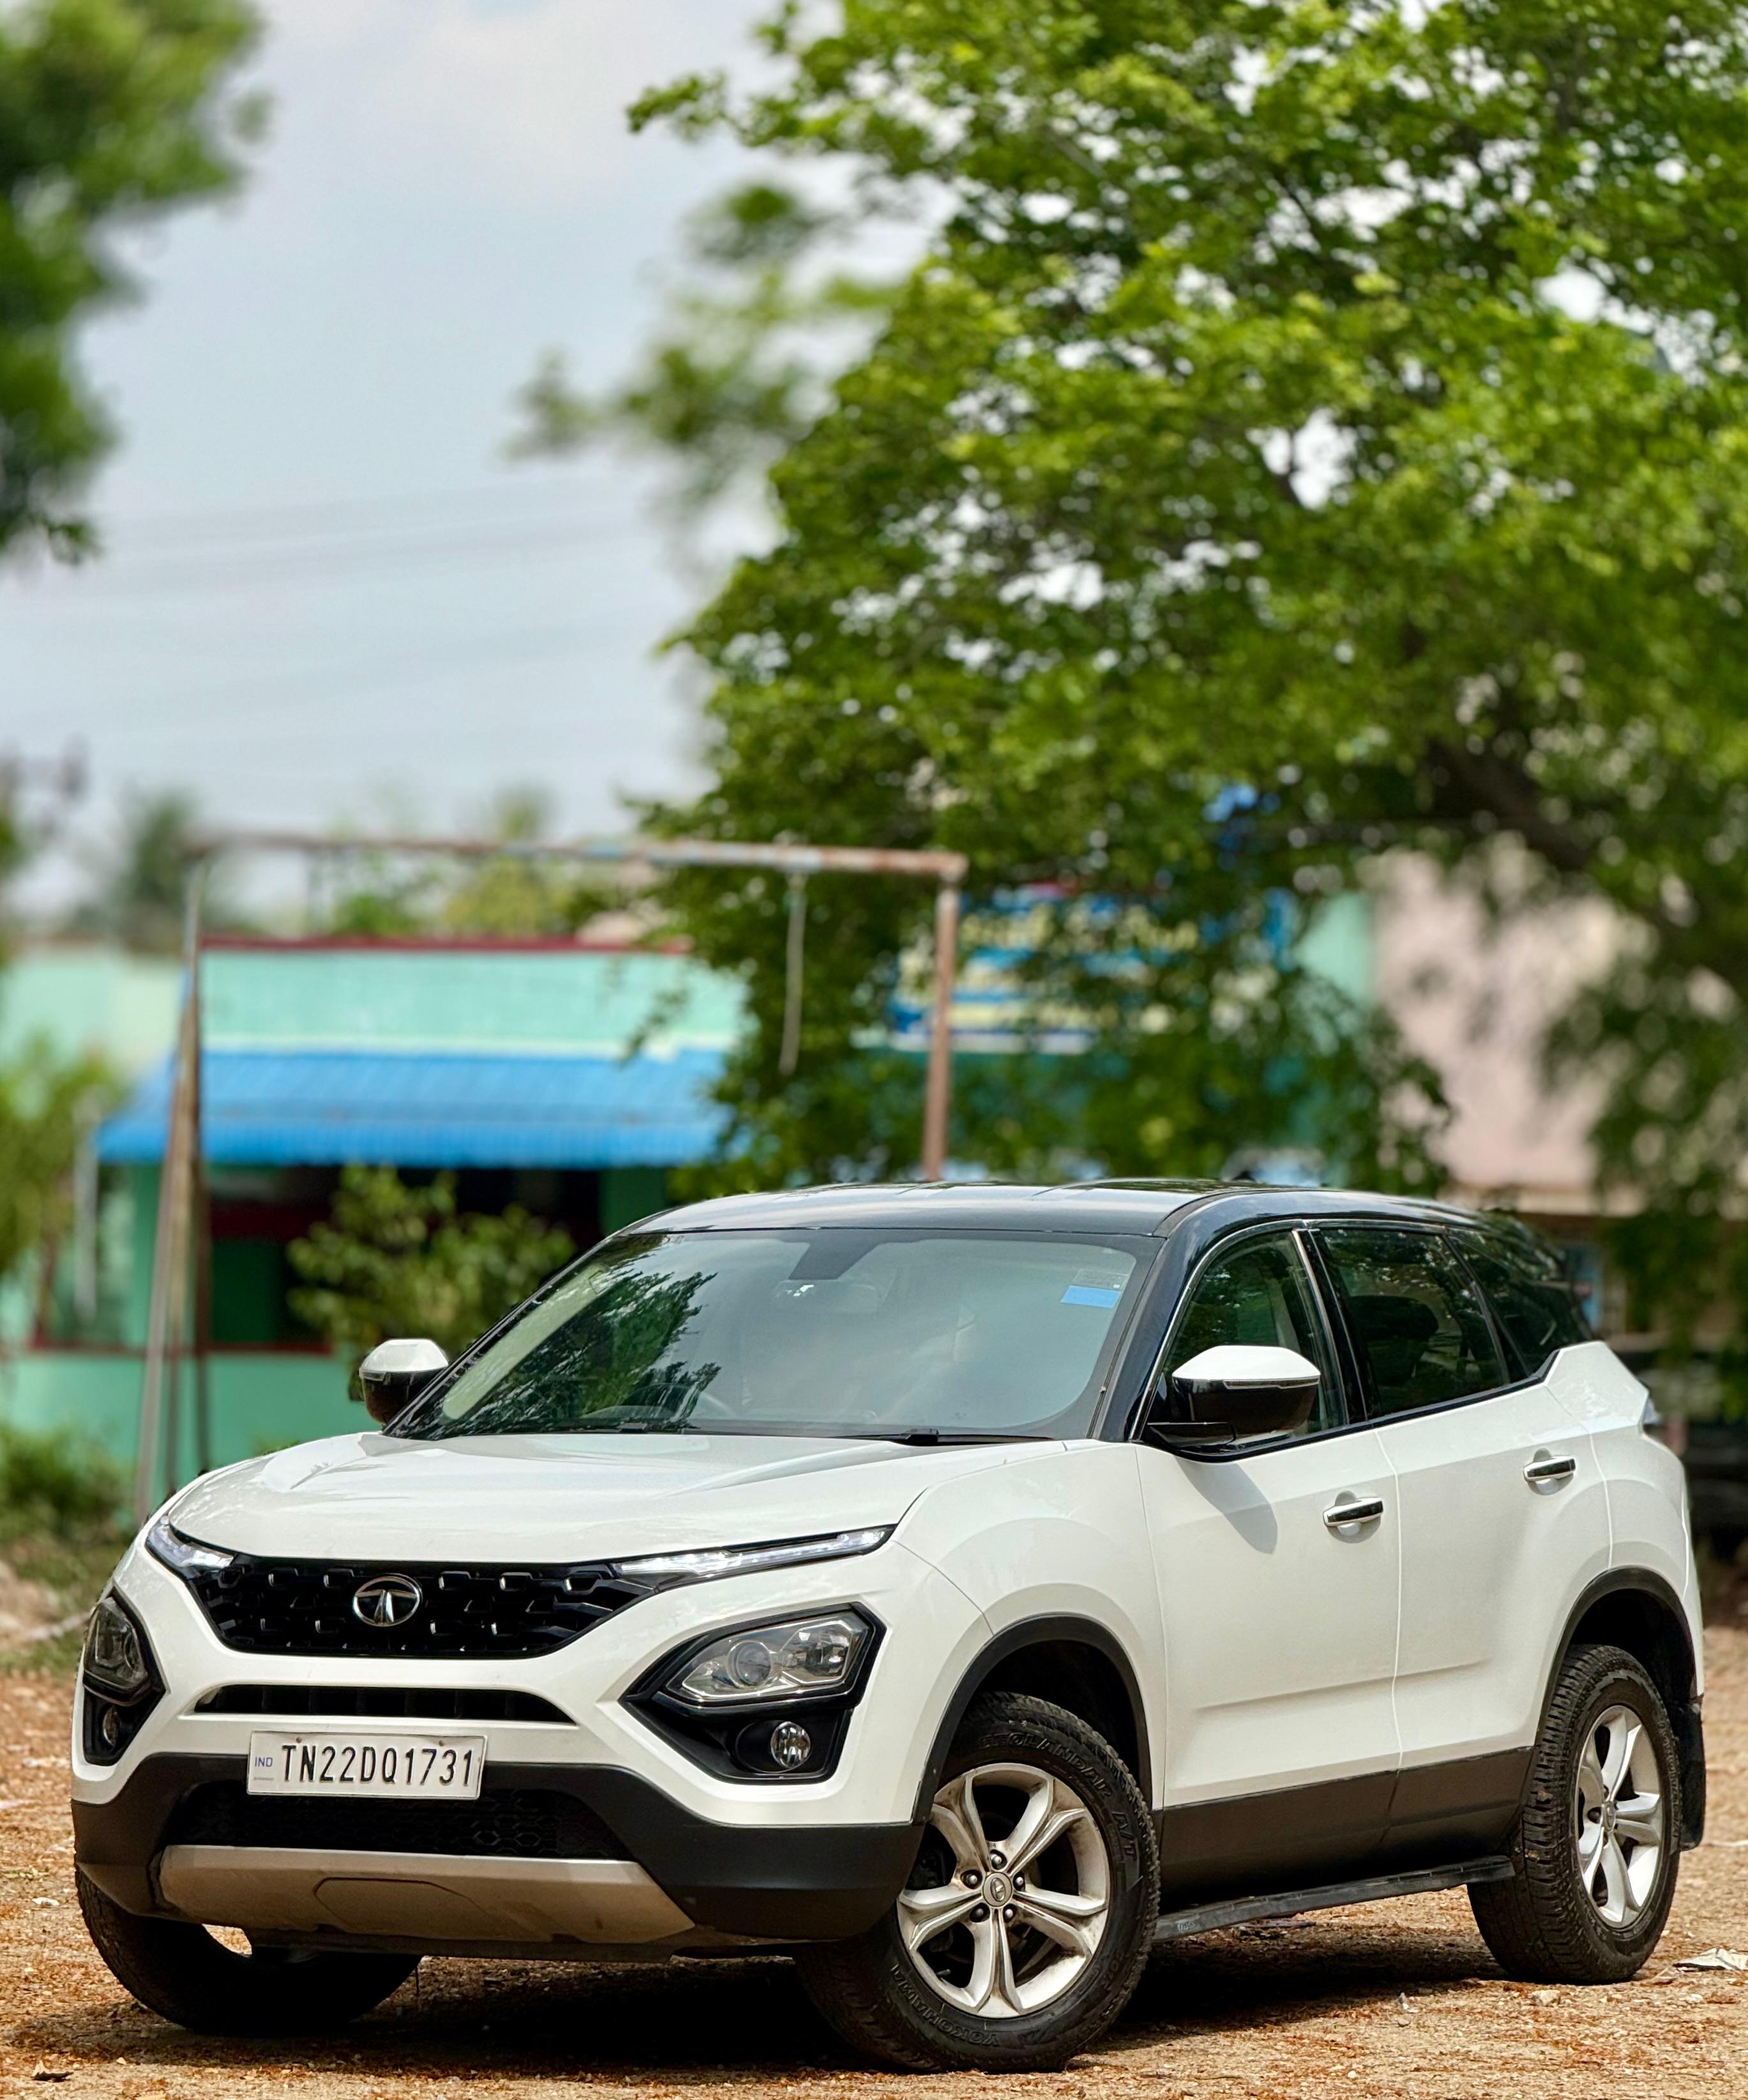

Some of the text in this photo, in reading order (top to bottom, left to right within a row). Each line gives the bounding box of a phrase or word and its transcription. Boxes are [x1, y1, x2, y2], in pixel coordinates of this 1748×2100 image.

[254, 1756, 273, 1768] IND
[282, 1744, 474, 1787] TN22DQ1731
[890, 1963, 1000, 2047] YOKOHAMA
